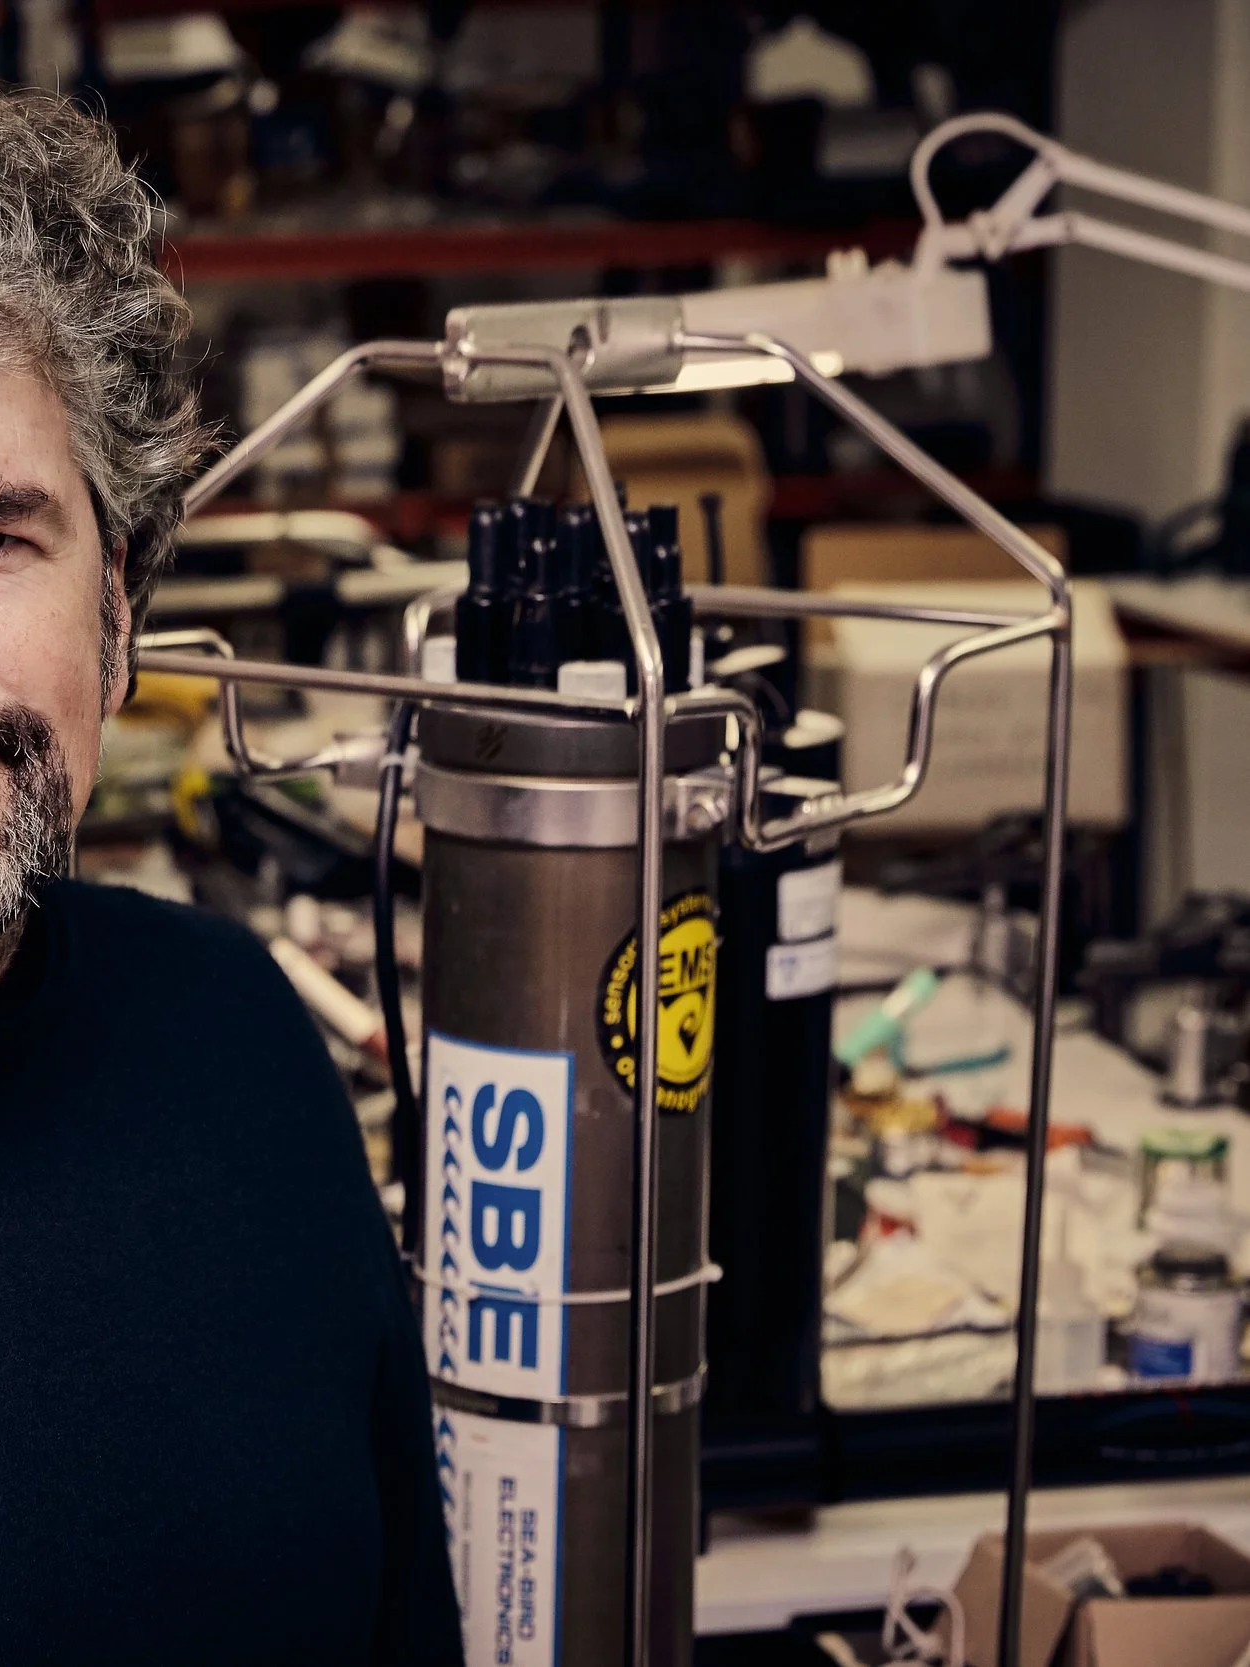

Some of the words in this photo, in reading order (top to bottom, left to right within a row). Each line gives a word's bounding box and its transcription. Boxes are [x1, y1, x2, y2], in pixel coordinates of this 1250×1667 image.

[467, 1084, 544, 1368] SBE
[495, 1477, 516, 1665] ELECTRONICS
[518, 1510, 537, 1640] SEA-BIRD
